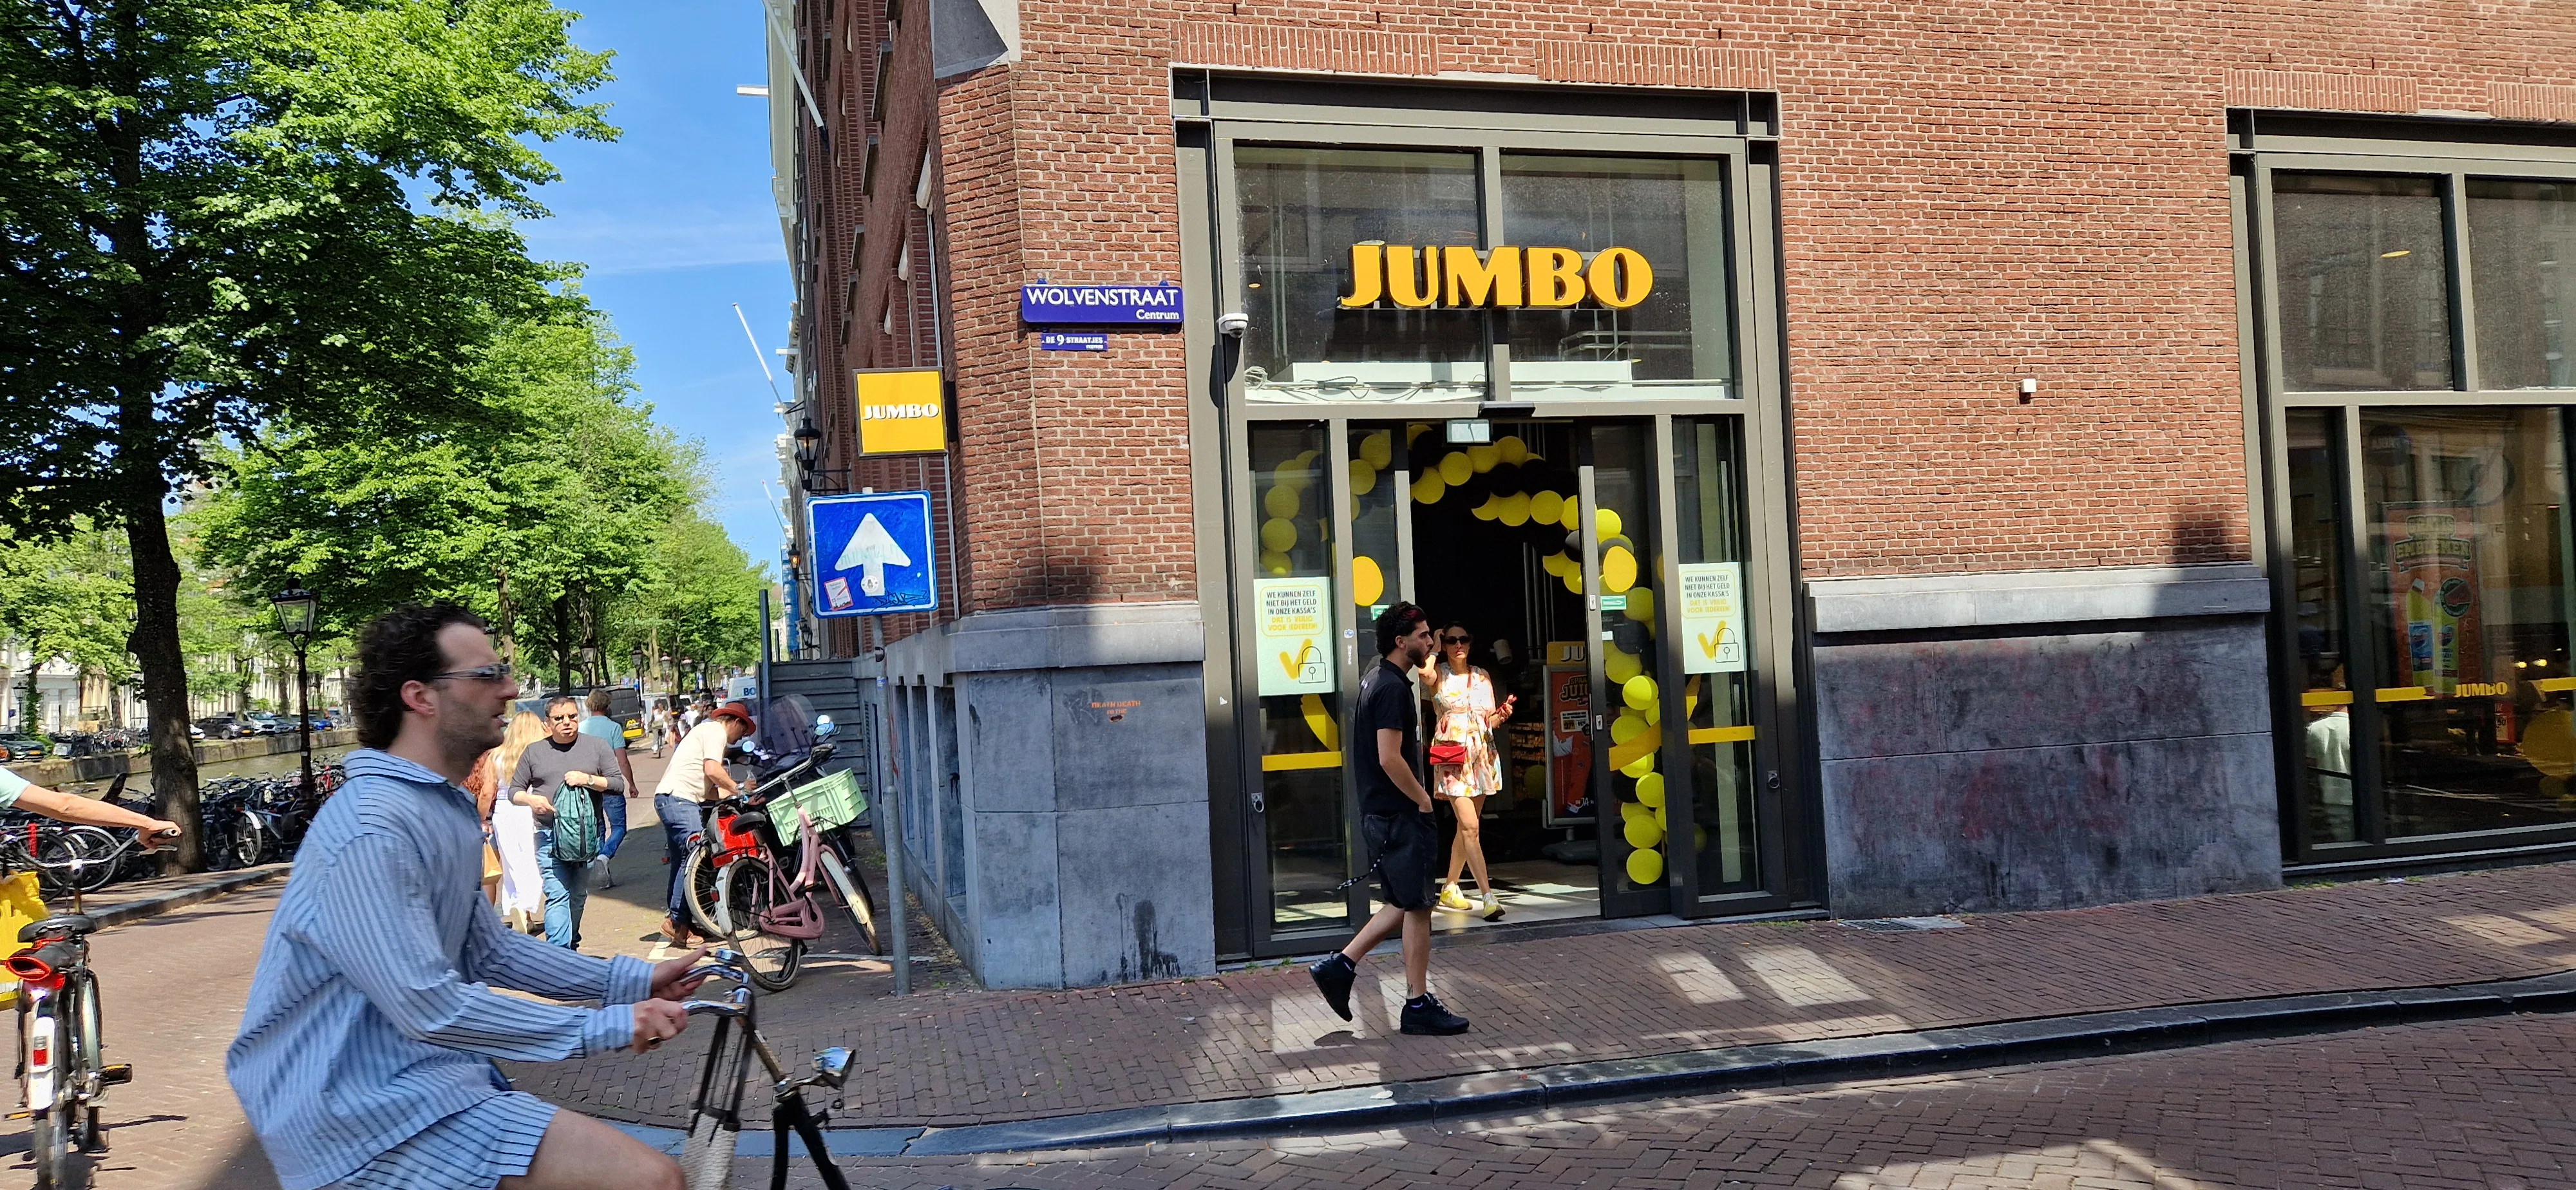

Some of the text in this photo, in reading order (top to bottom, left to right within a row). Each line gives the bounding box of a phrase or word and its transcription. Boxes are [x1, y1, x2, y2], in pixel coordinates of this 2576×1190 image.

[1340, 244, 1653, 308] JUMBO
[1026, 288, 1179, 306] WOLVENSTRAAT
[1135, 309, 1180, 320] Centrum
[1057, 334, 1065, 346] 9
[863, 402, 939, 420] JUMBO
[2454, 682, 2508, 698] JUMBO
